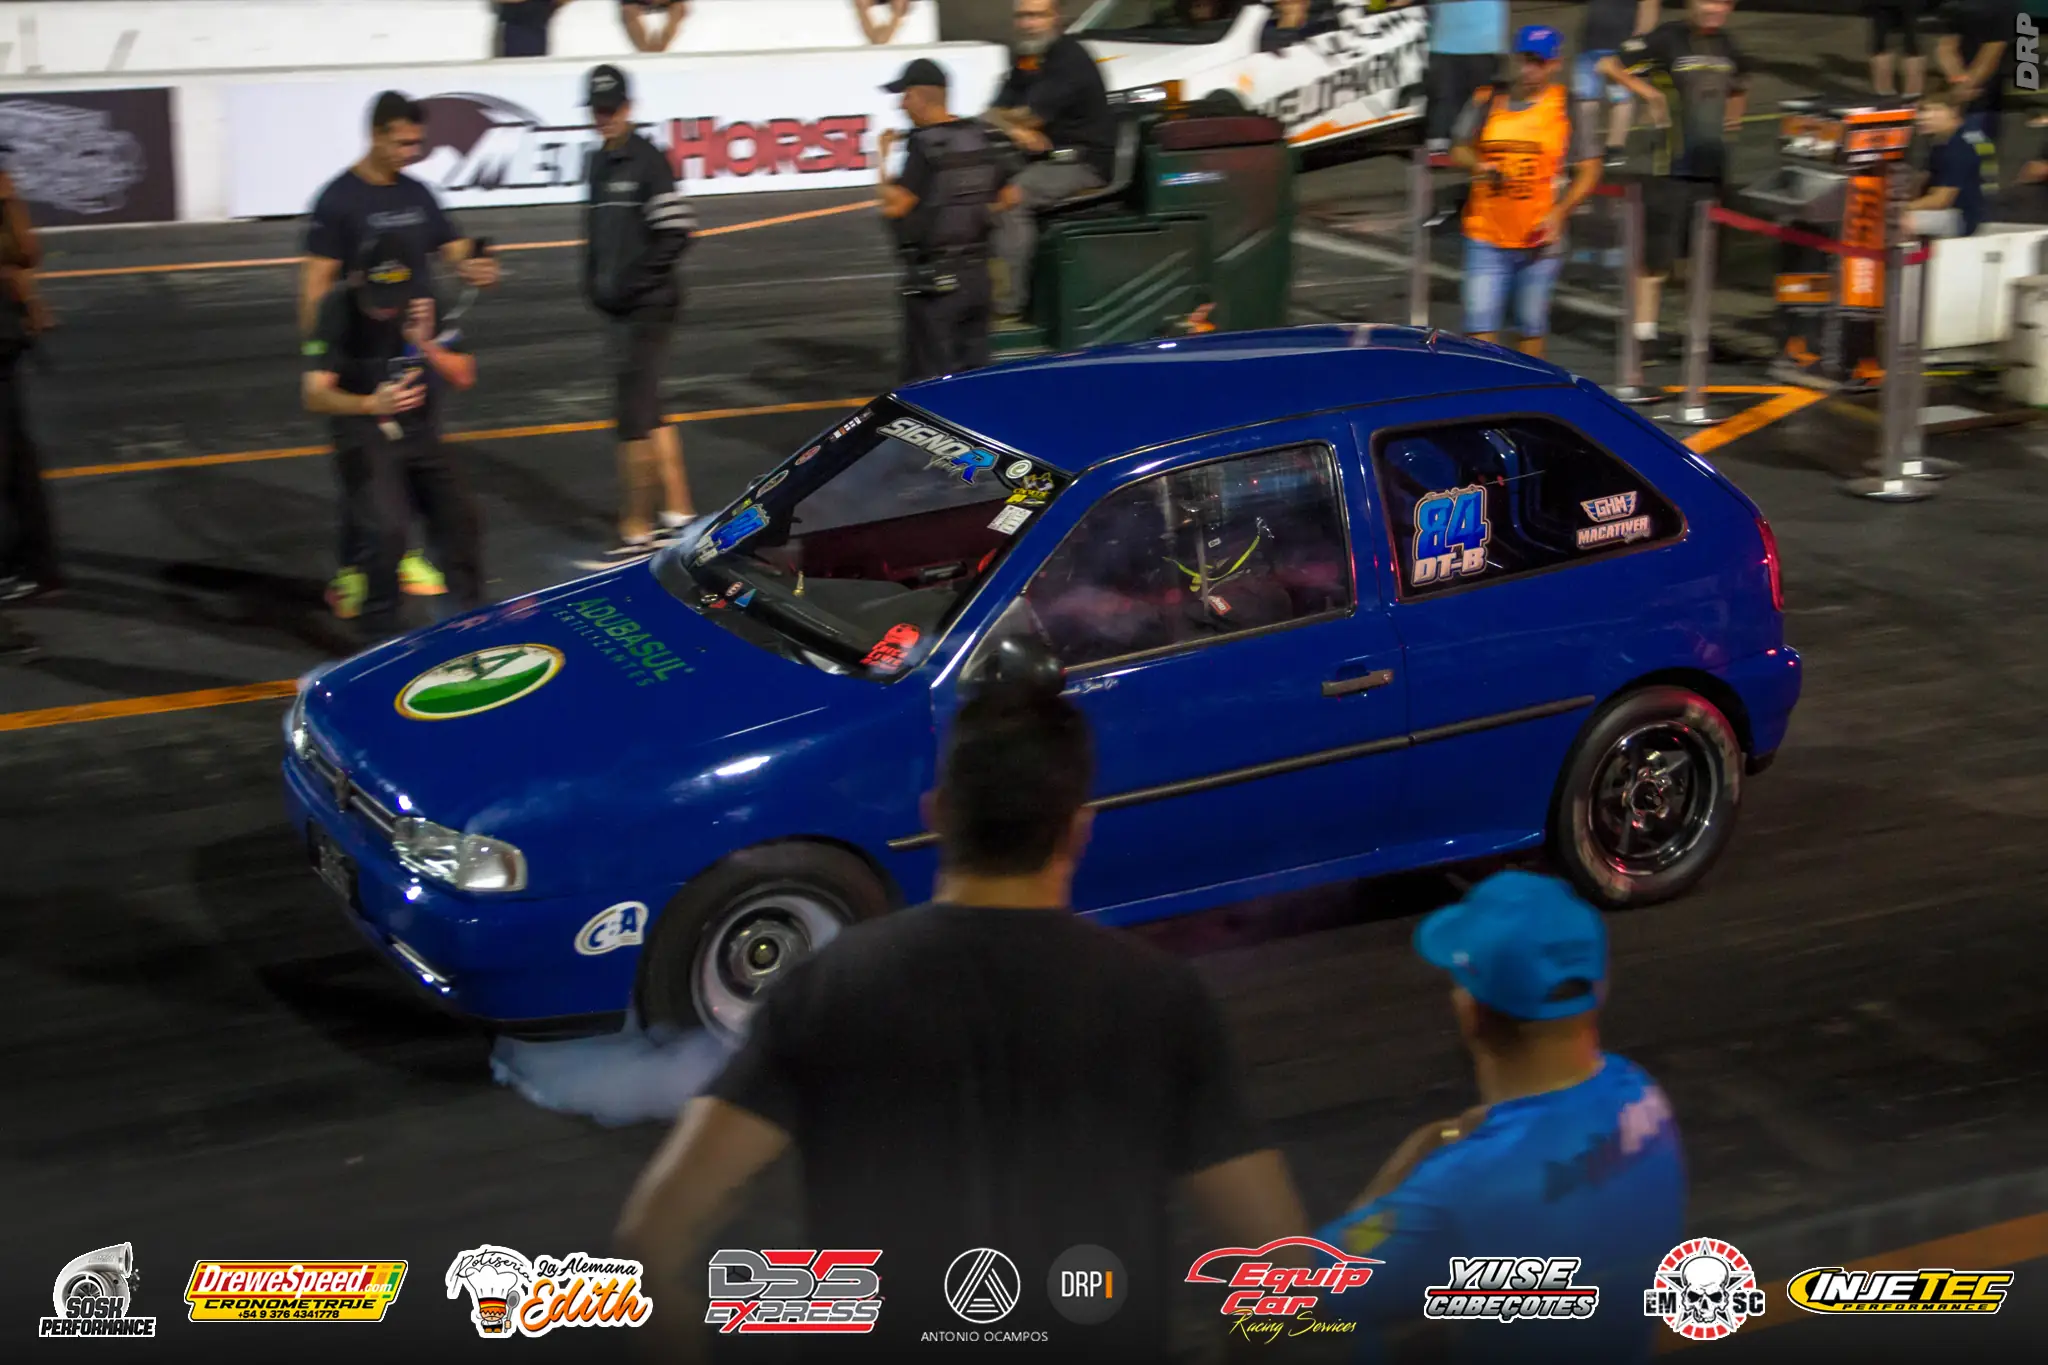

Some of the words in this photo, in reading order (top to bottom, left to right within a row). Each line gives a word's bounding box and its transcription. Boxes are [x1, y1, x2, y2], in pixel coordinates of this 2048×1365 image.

[1417, 491, 1487, 559] 84
[1414, 547, 1485, 583] DT-B
[567, 598, 687, 682] ADUBASUL
